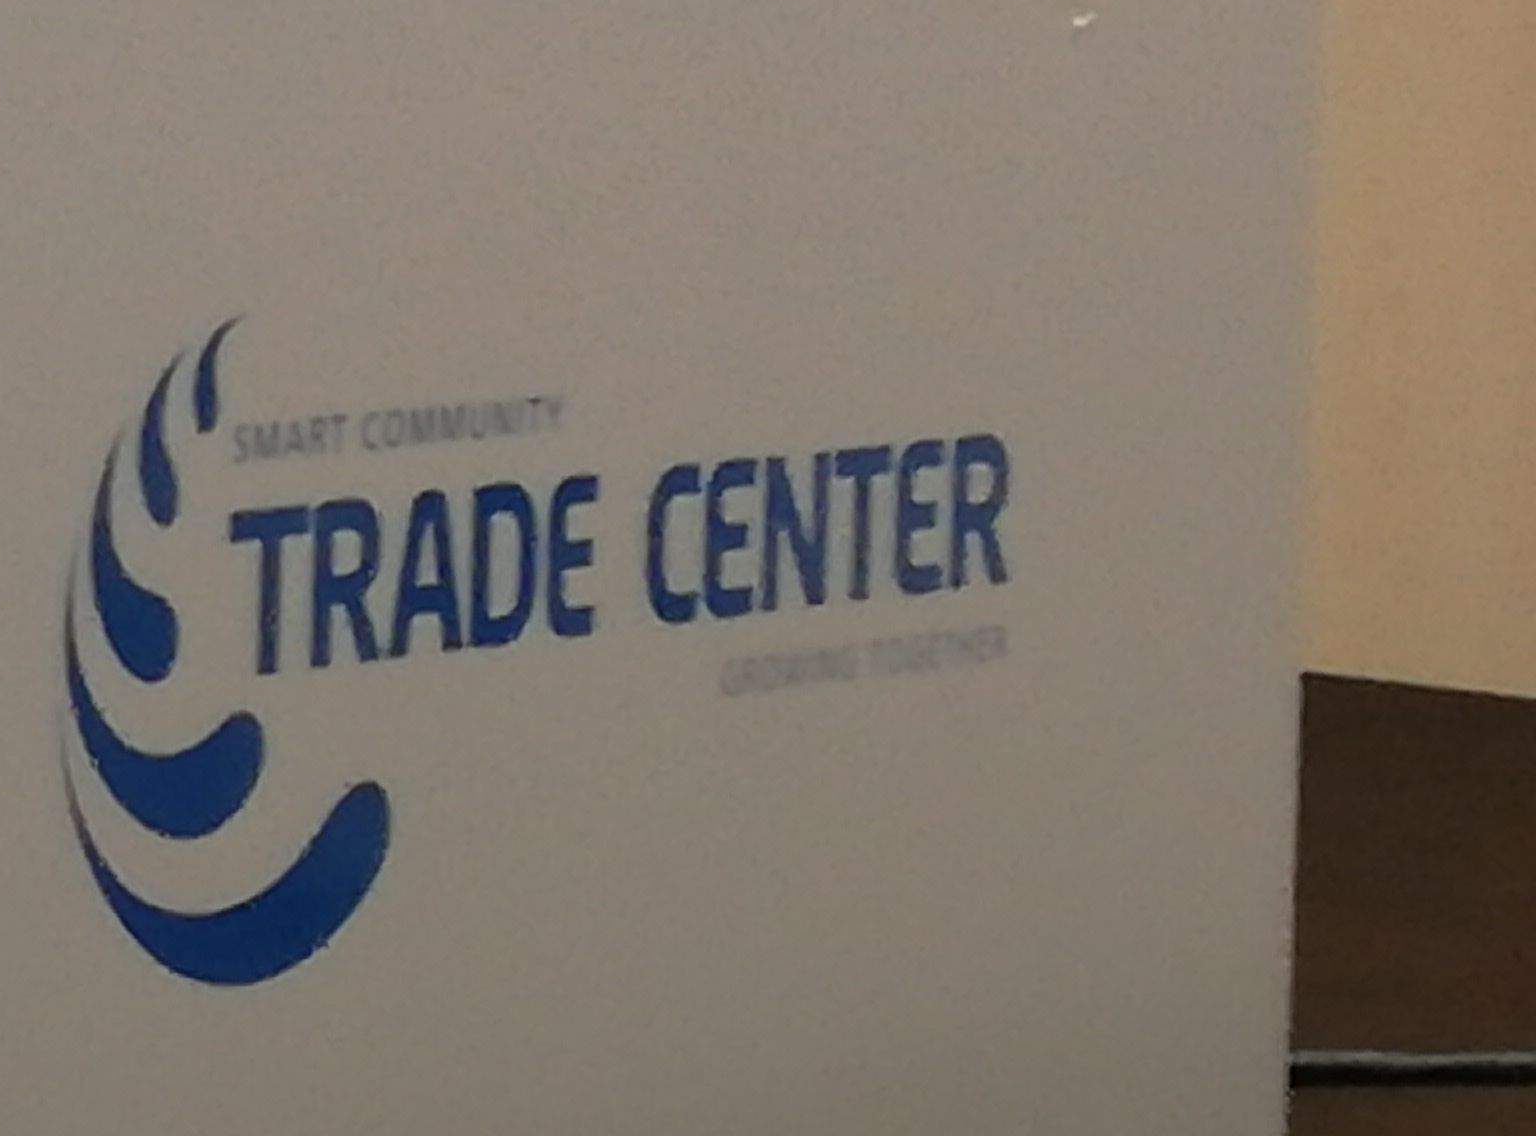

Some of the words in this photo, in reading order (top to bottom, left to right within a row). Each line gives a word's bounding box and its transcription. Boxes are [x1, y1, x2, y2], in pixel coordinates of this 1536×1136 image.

[232, 412, 350, 464] SMART
[360, 395, 566, 451] COMMUNITY
[228, 474, 602, 676] TRADE
[644, 432, 1013, 626] CENTER
